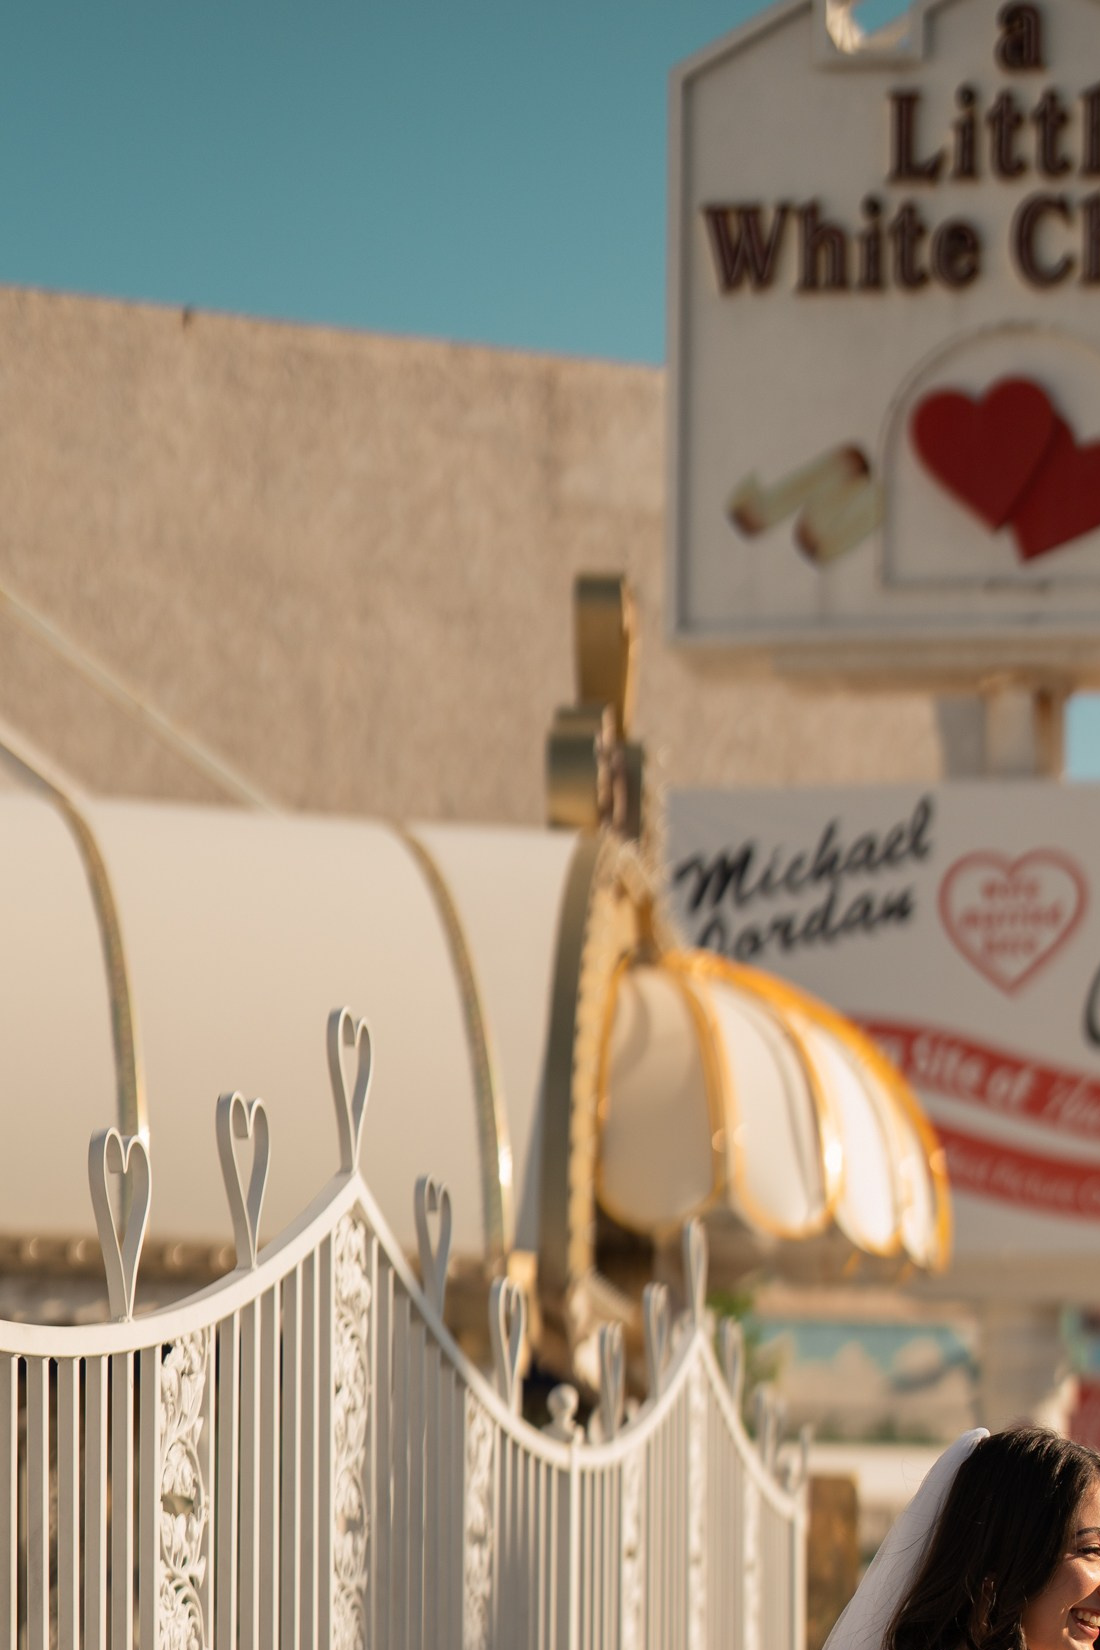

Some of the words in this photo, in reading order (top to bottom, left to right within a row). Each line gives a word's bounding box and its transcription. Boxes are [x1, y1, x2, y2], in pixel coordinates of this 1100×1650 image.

[995, 1, 1045, 72] a
[702, 192, 982, 295] White
[673, 794, 934, 917] Michael
[986, 1066, 1034, 1110] of
